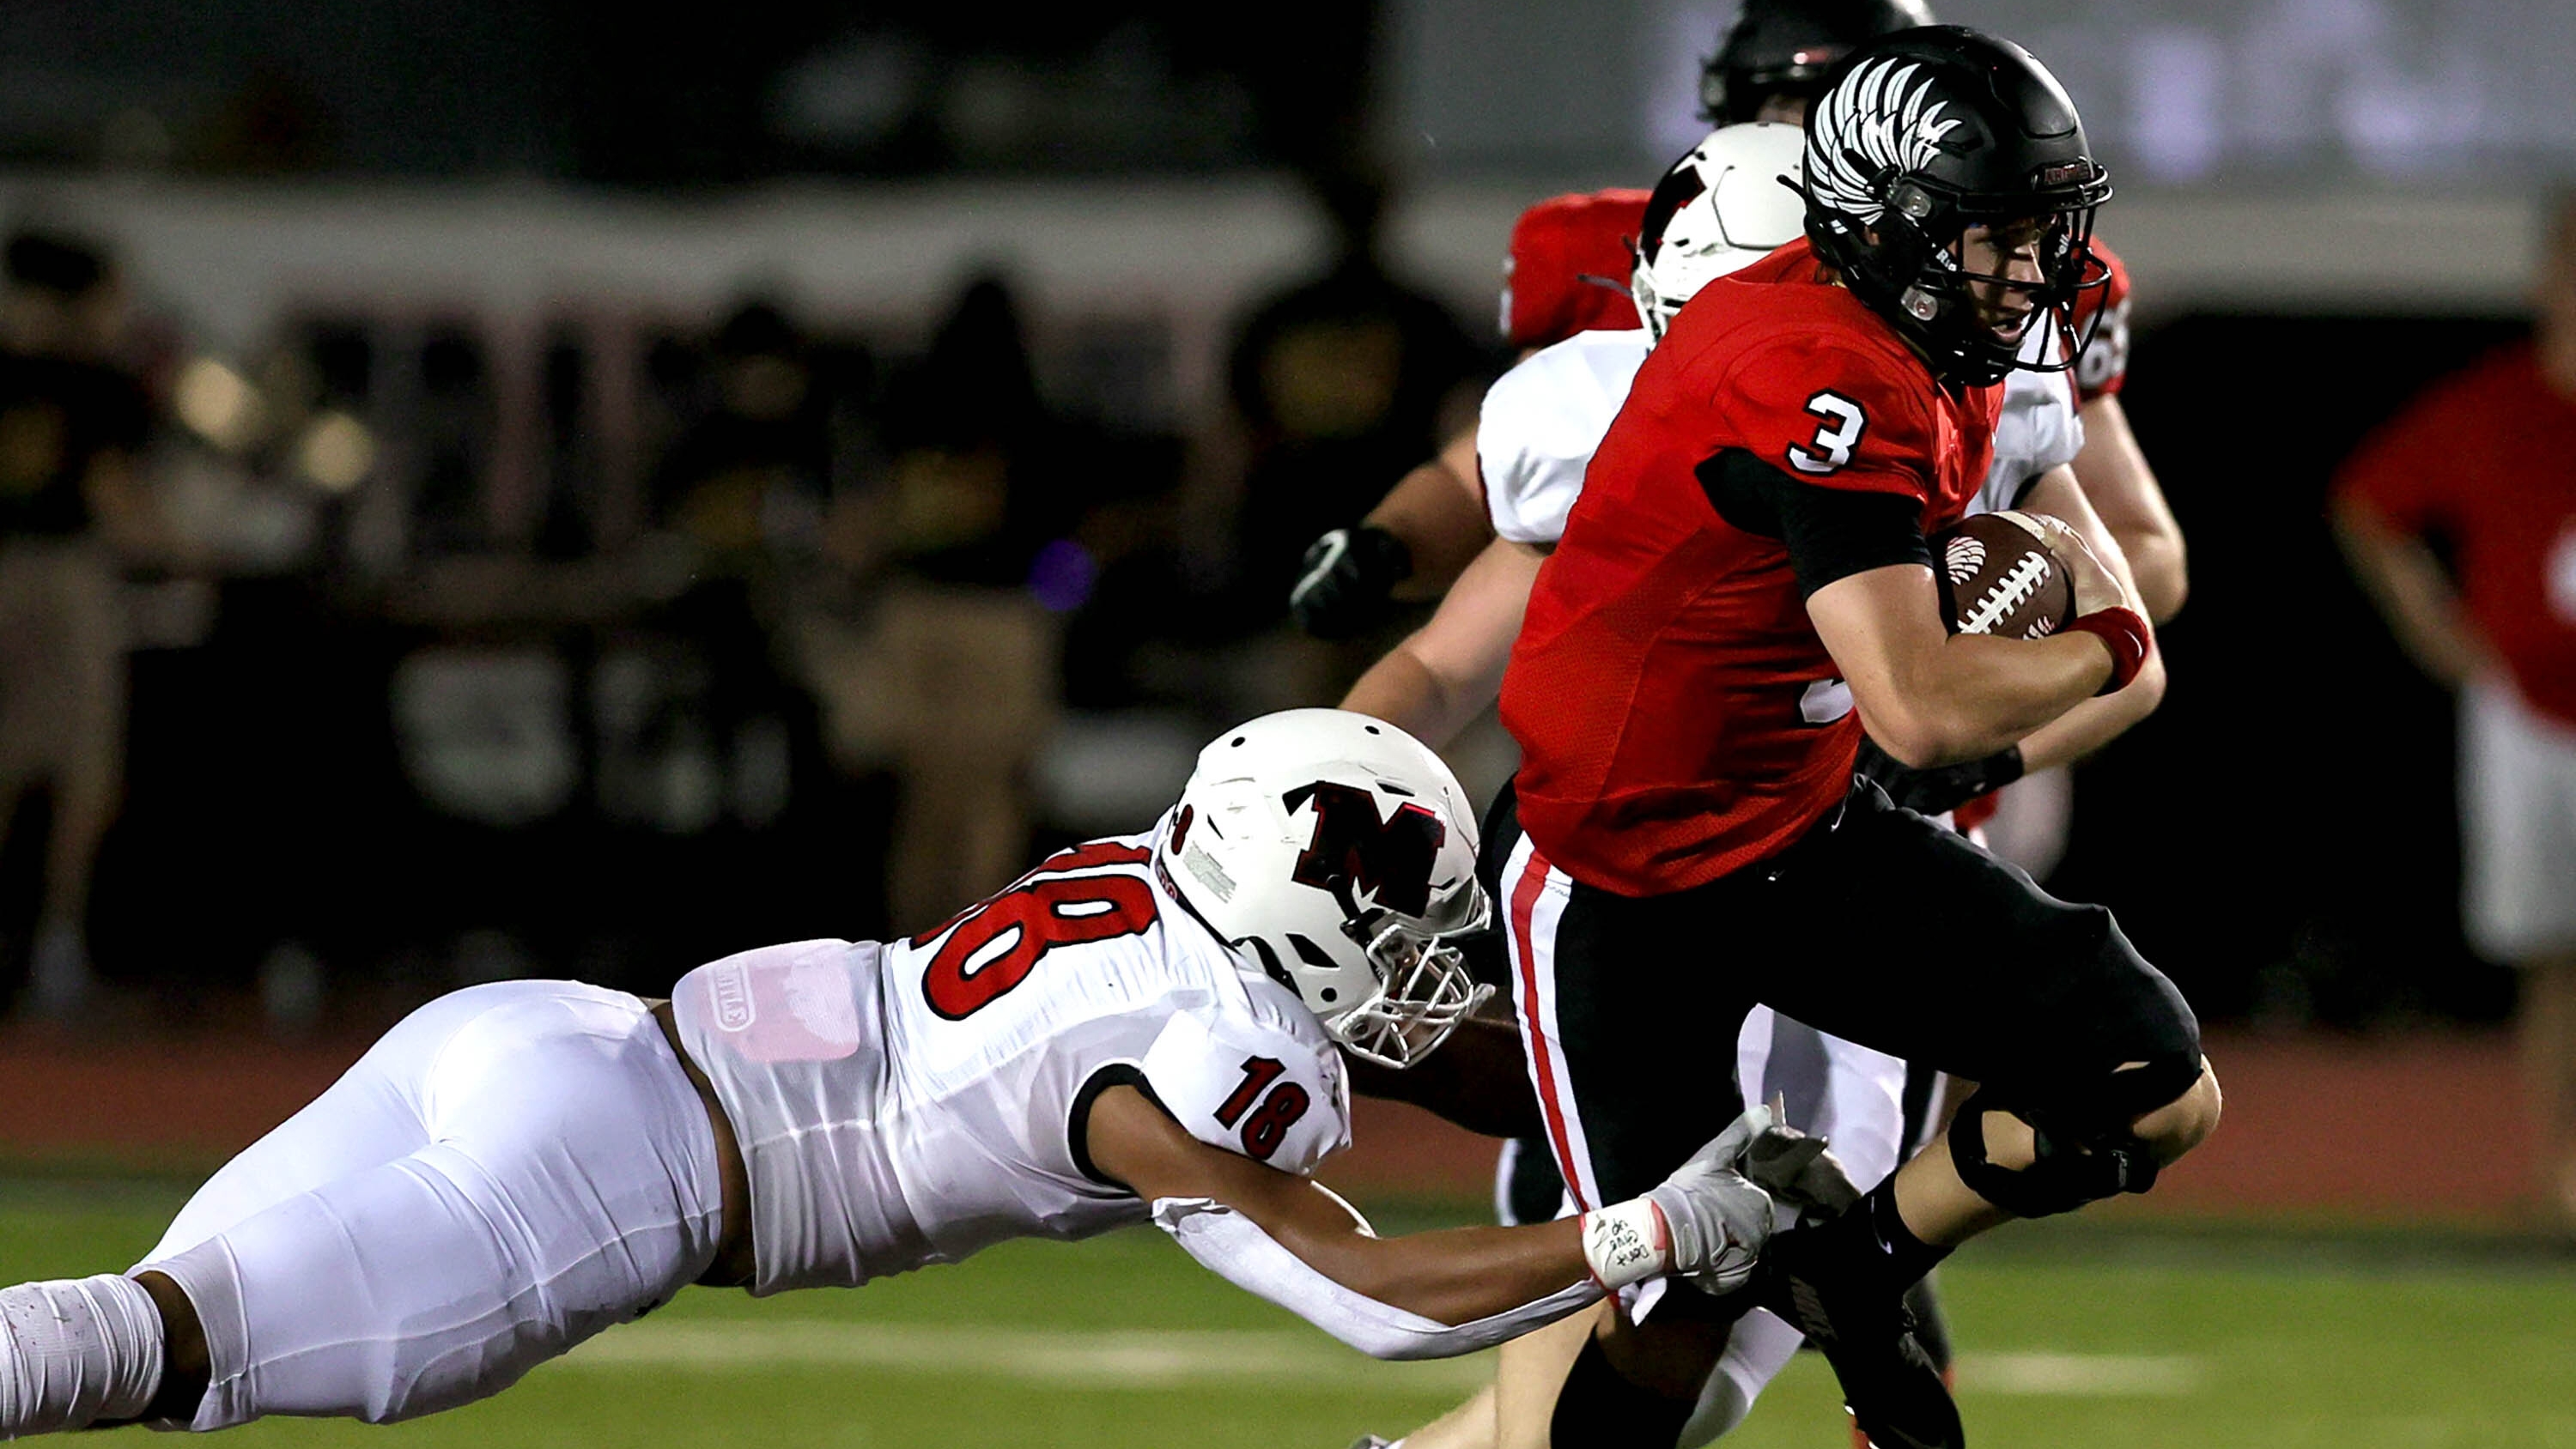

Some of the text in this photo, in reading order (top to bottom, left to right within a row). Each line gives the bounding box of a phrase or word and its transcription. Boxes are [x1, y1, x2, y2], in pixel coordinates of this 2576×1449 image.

[1788, 389, 1868, 476] 3
[1291, 780, 1446, 919] M
[1212, 1055, 1310, 1161] 18
